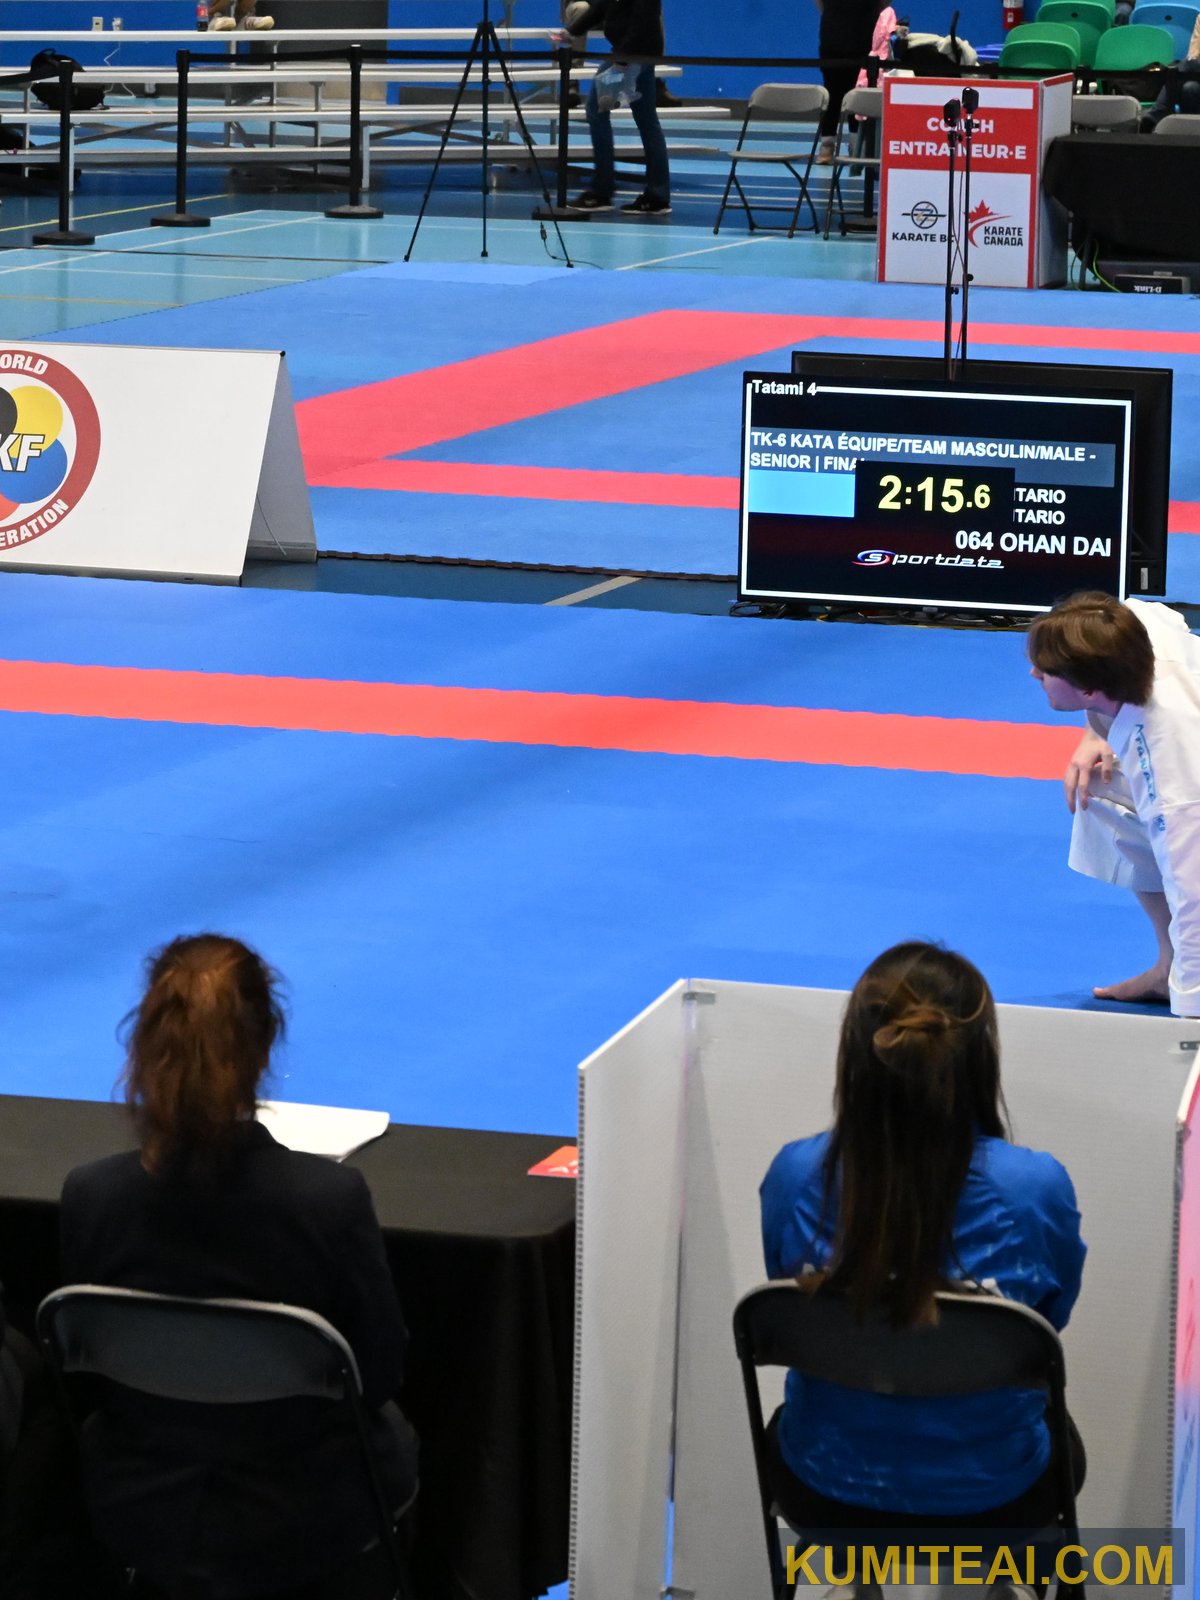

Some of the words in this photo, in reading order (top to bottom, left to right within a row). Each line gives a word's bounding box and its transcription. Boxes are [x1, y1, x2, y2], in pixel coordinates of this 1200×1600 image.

[889, 140, 1027, 159] ENTRANEUR·E
[892, 232, 937, 242] KARATE
[984, 226, 1023, 237] KARATE
[984, 236, 1023, 247] CANADA
[752, 379, 804, 396] Tatami
[807, 382, 818, 396] 4
[751, 432, 787, 447] TK-6
[790, 433, 834, 449] KATA
[838, 432, 947, 455] ÉQUIPE/TEAM
[951, 441, 1086, 462] MASCULIN/MALE
[750, 452, 811, 469] SENIOR
[823, 456, 863, 471] FINA
[878, 475, 991, 513] 2:15.6
[1014, 487, 1066, 504] TARIO
[1013, 508, 1066, 525] TARIO
[955, 530, 994, 551] 064
[1000, 532, 1066, 555] OHAN
[1073, 536, 1111, 557] DAI
